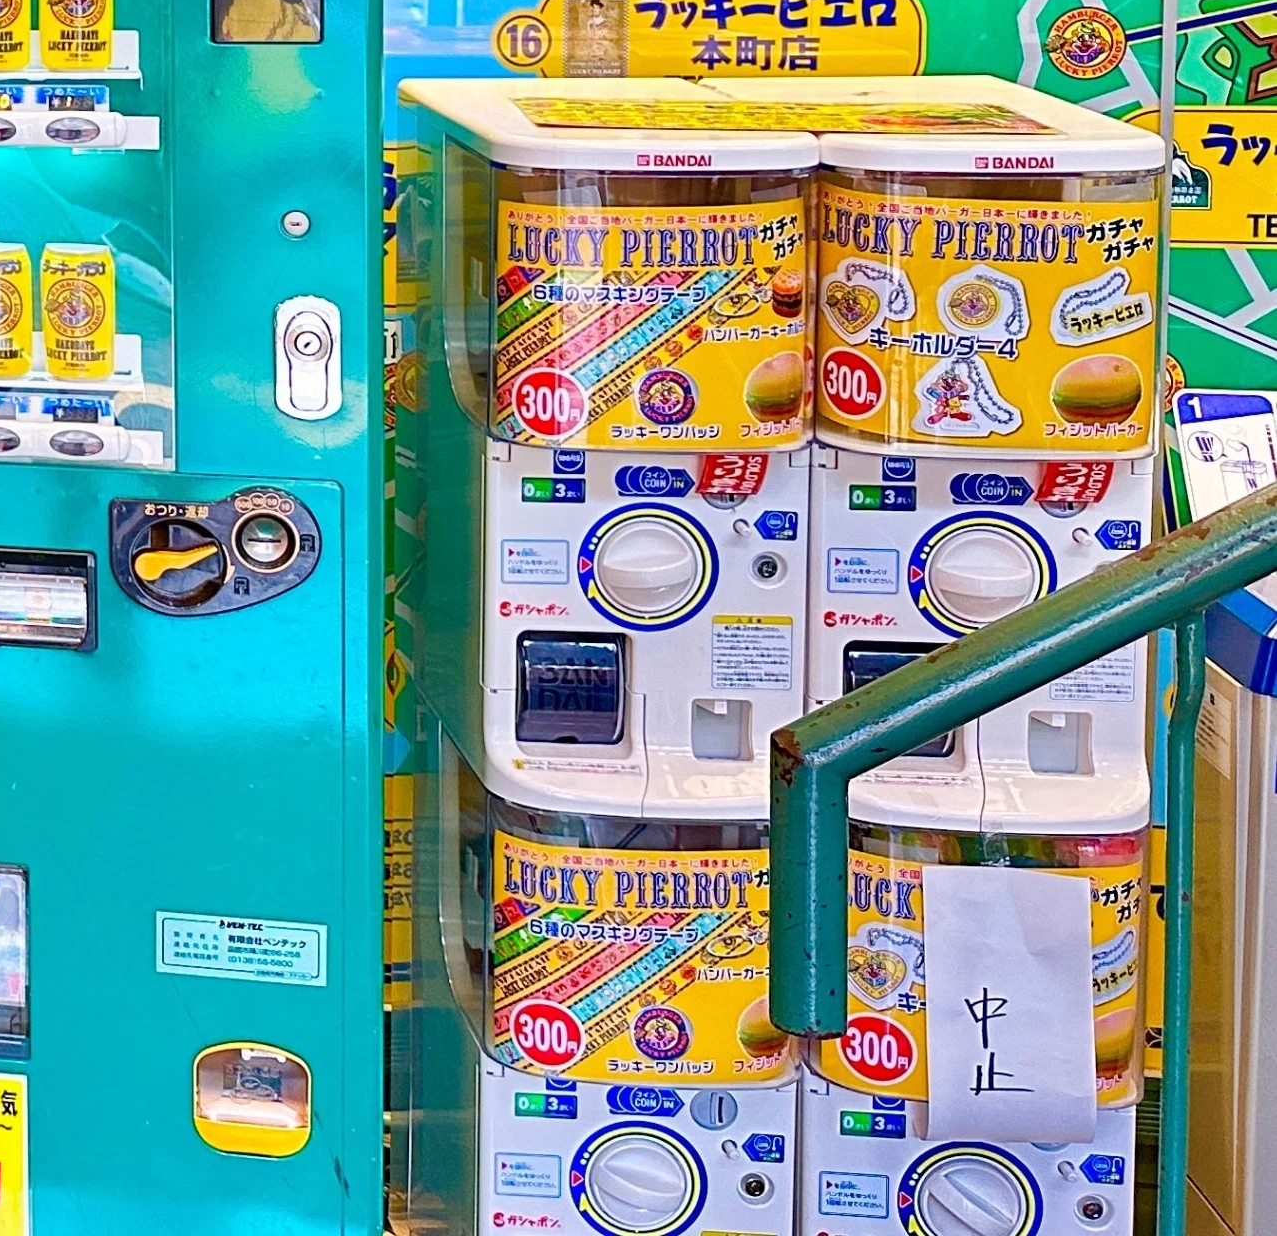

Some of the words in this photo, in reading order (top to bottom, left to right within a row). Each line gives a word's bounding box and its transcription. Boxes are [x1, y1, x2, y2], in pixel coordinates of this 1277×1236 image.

[506, 24, 542, 57] 16
[692, 36, 820, 71] 本町店
[653, 154, 712, 167] BANDAI
[993, 156, 1054, 169] BANDAI
[507, 223, 609, 266] LUCKY
[620, 225, 758, 266] PIERROT
[822, 204, 921, 256] LUCKY
[933, 220, 1085, 263] PIERROT
[1086, 217, 1143, 244] ガチャ
[1103, 237, 1154, 263] ガチャ
[533, 284, 707, 304] 6種のマスキングテープ
[1069, 304, 1144, 334] ラッキーピエロ
[869, 329, 1018, 358] キーホルダー4
[826, 362, 877, 405] 300円
[521, 385, 580, 422] 300円
[503, 855, 603, 904] LUCKY
[616, 869, 753, 909] PIERROT
[529, 920, 700, 943] 6種のマスキングテープ
[518, 1015, 578, 1055] 300円
[846, 1029, 909, 1070] 300円
[965, 988, 1035, 1095] 中止
